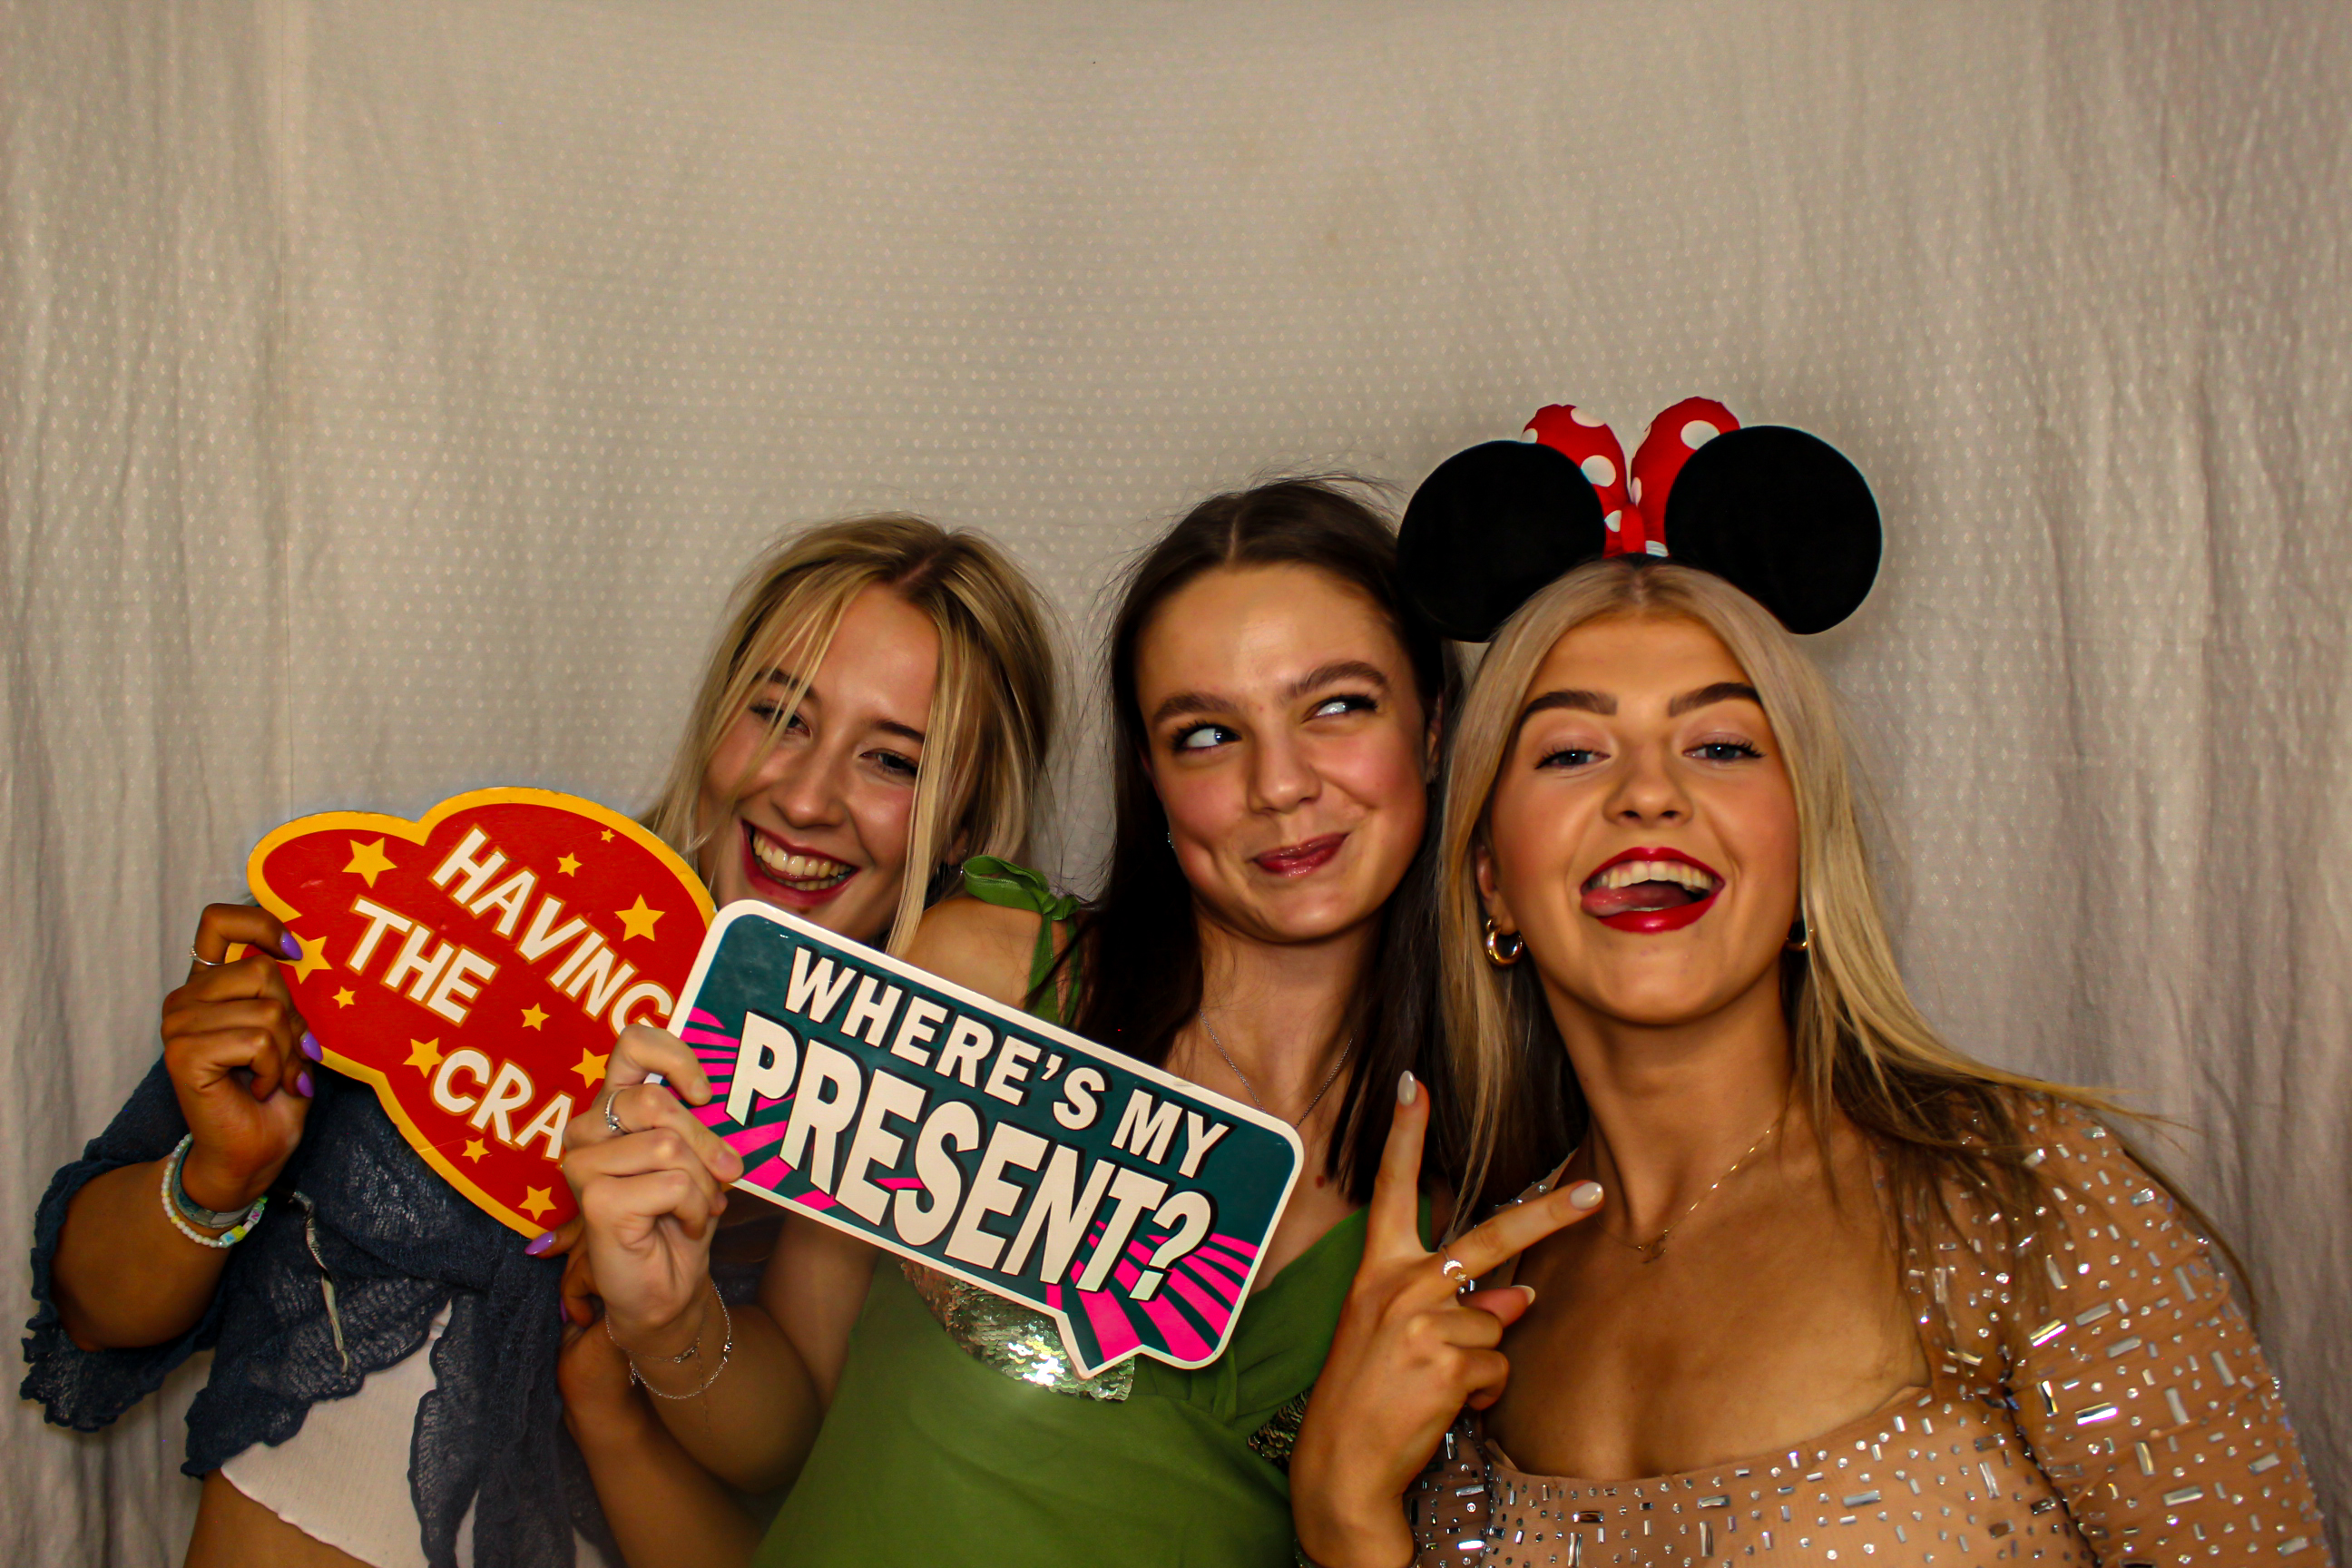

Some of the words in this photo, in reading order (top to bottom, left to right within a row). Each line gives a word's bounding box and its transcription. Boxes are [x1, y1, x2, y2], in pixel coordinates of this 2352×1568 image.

[345, 895, 500, 1027] THE
[430, 824, 675, 1038] HAVING
[430, 1046, 575, 1170] CRA
[725, 1011, 1217, 1301] PRESENT?
[783, 946, 1113, 1131] WHERE'S
[1111, 1089, 1230, 1179] MY
